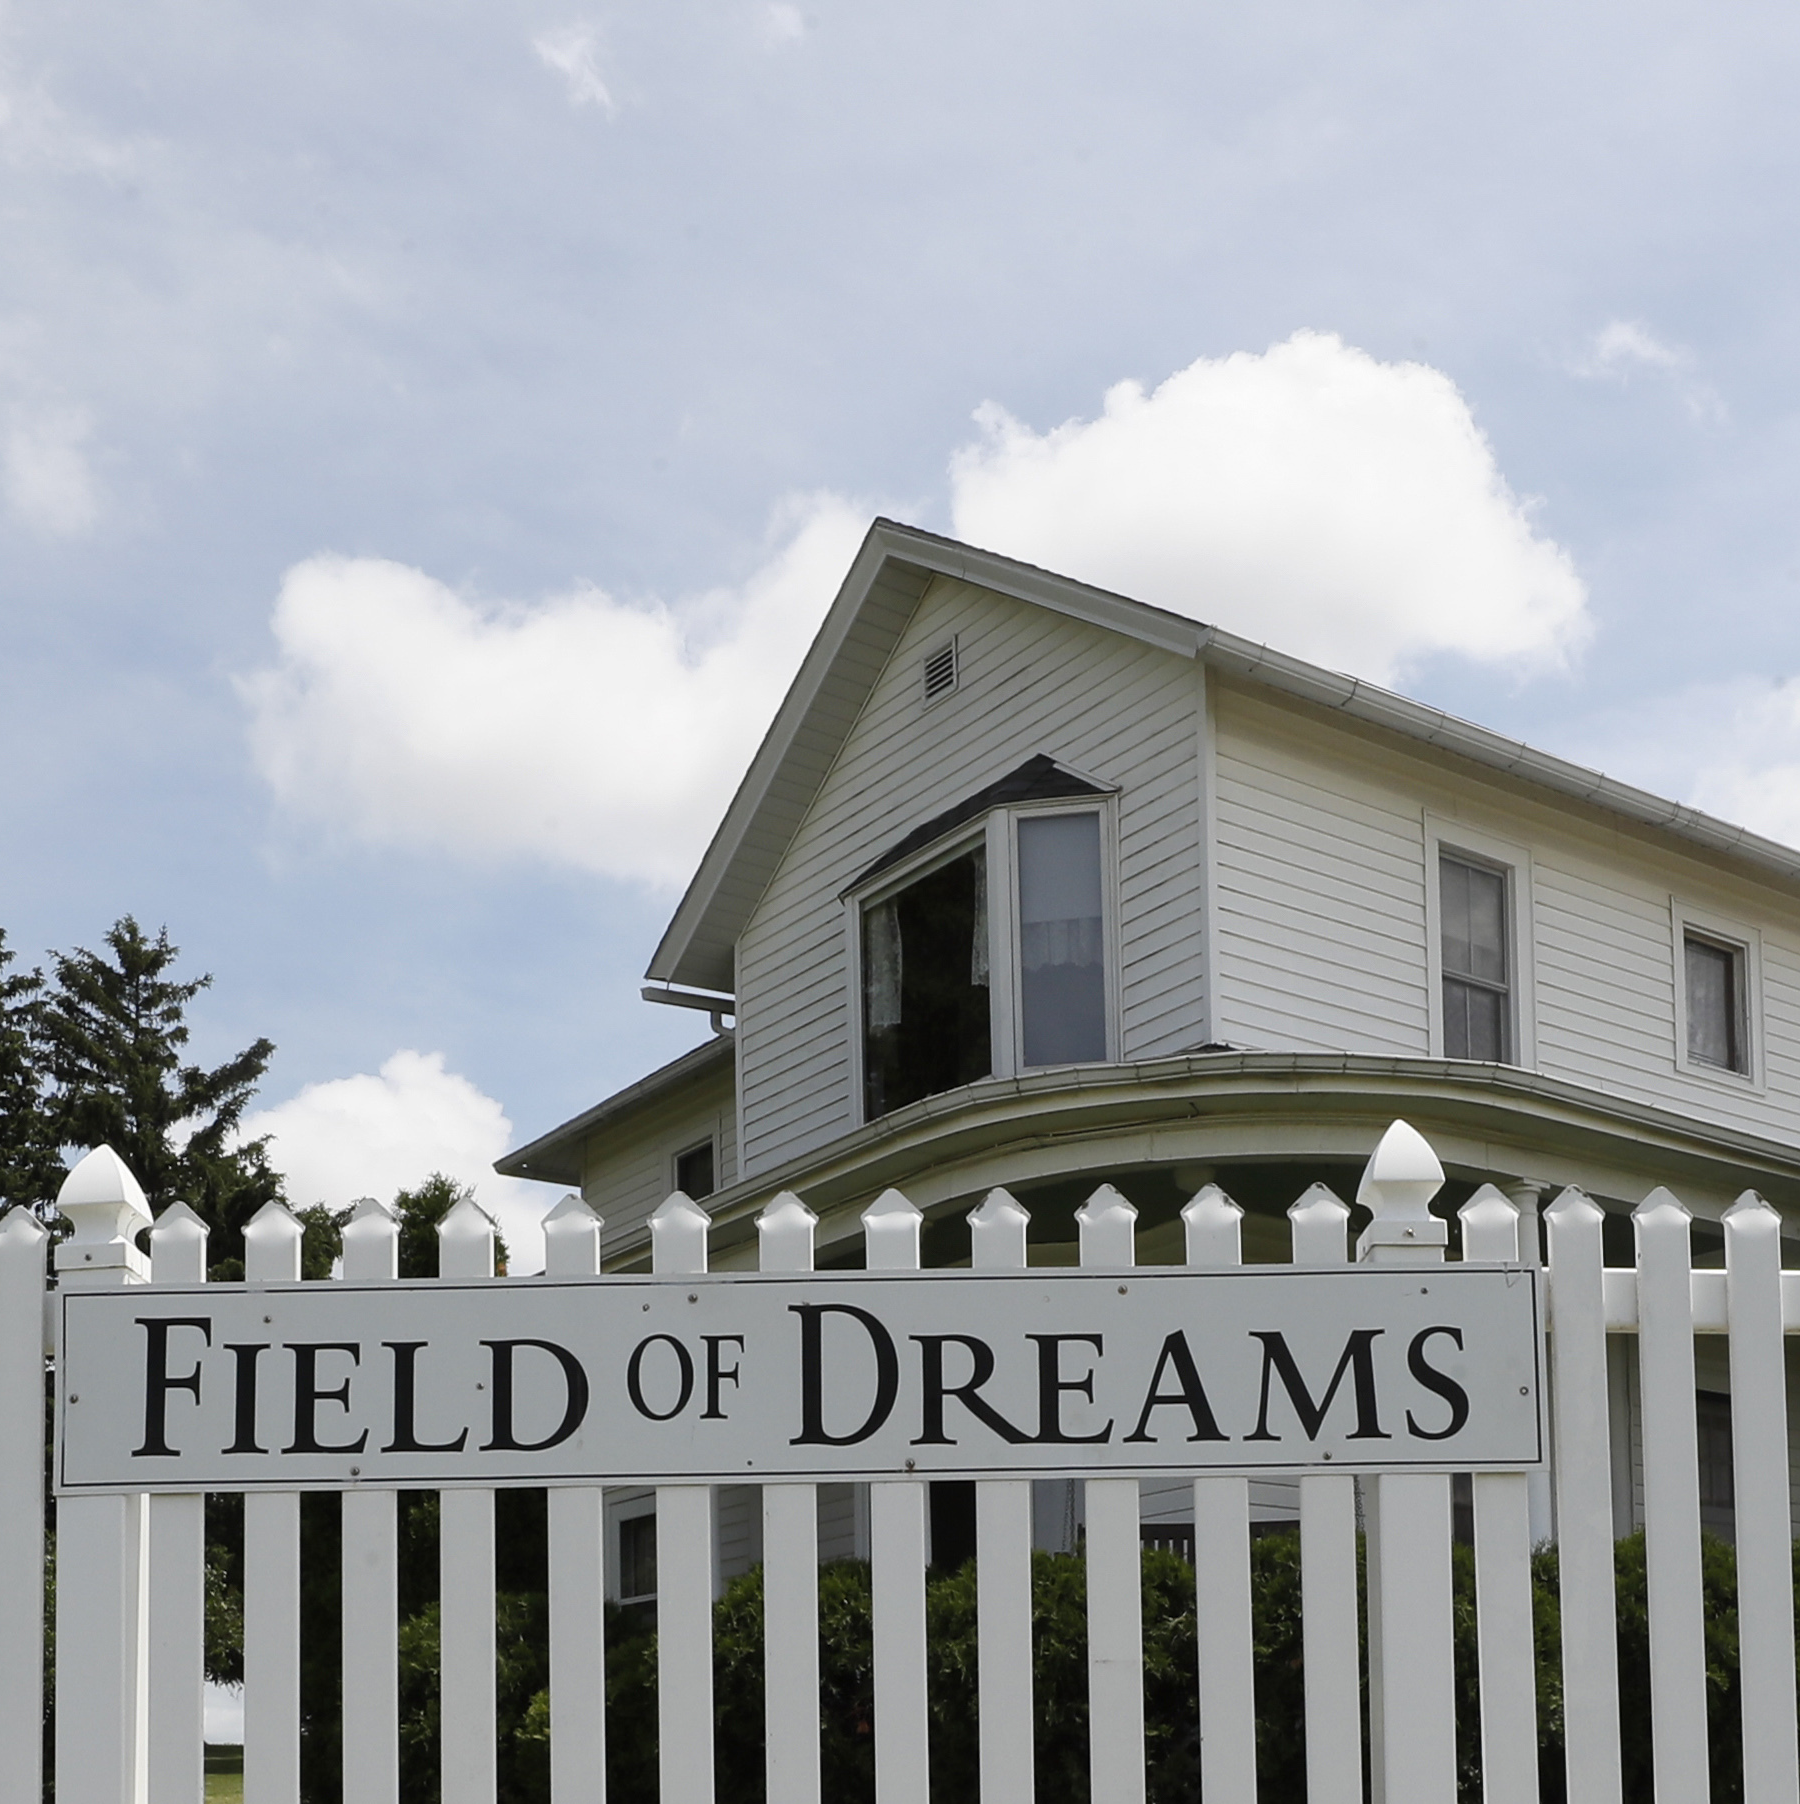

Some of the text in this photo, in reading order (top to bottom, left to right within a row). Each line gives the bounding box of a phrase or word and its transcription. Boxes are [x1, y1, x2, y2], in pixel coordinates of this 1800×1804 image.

[129, 1300, 1471, 1459] FIELD OF DREAMS
